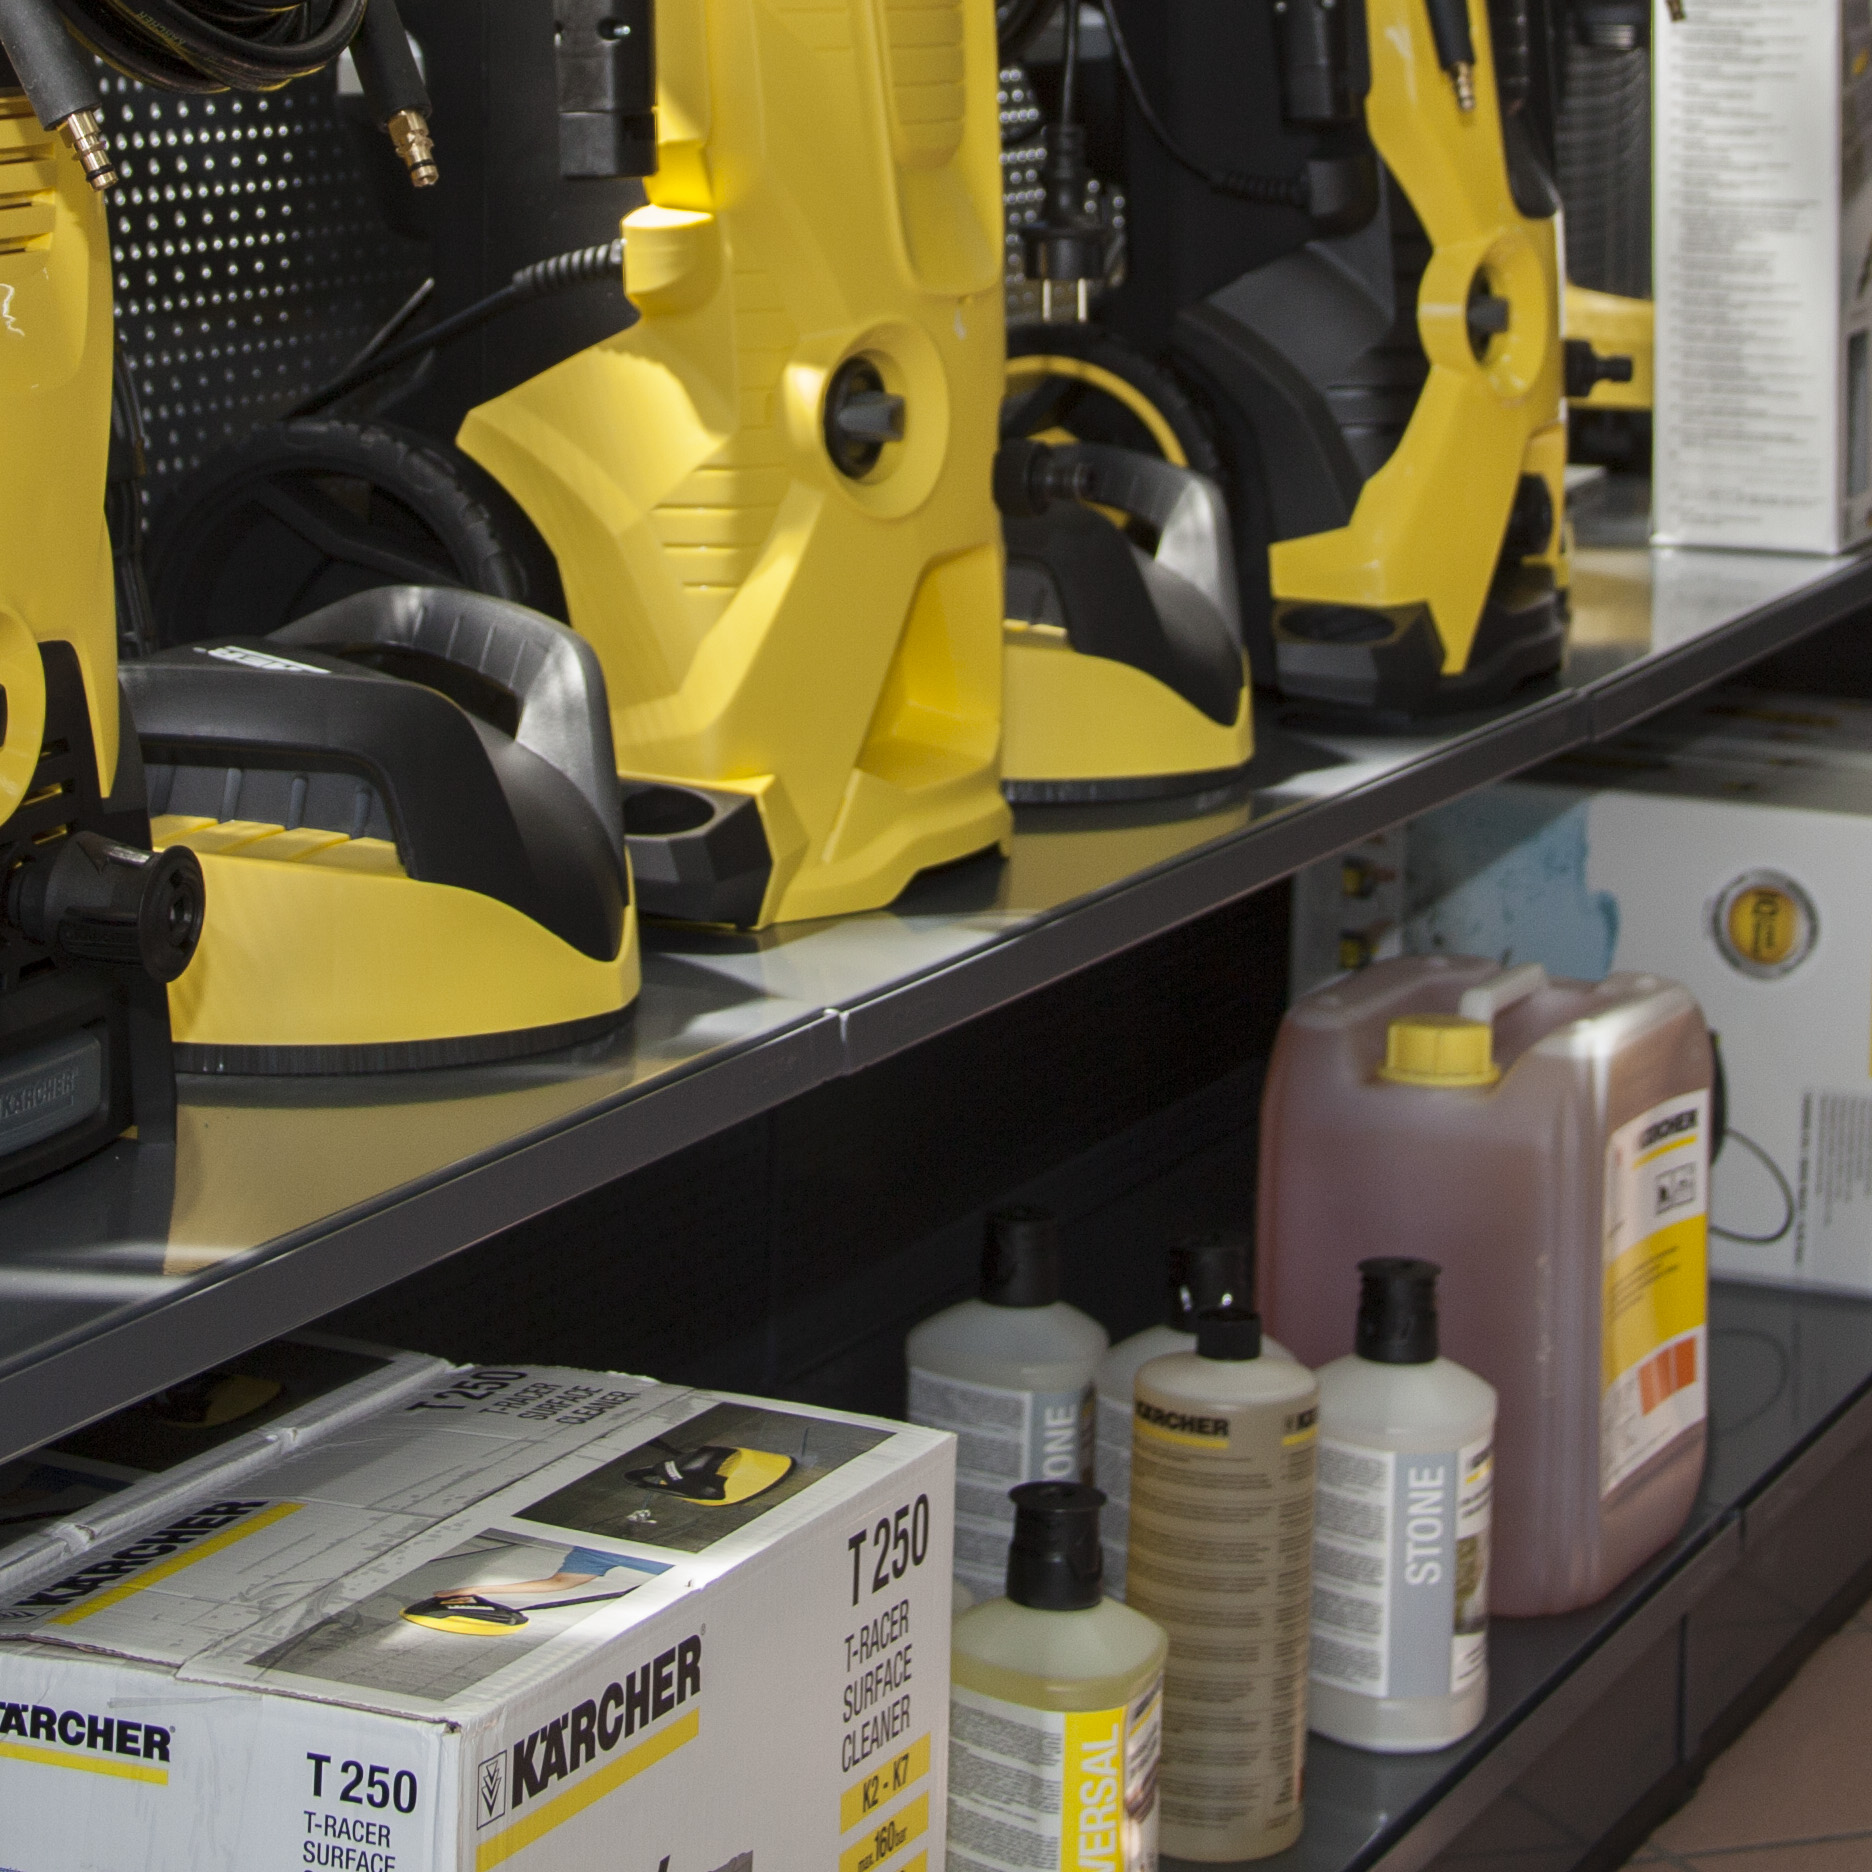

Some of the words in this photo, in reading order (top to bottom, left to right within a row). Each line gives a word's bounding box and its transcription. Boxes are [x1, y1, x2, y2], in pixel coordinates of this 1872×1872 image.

[404, 1400, 467, 1413] T
[433, 1370, 529, 1401] 250
[478, 1382, 564, 1415] T-RACER
[12, 1500, 270, 1607] KÄRCHER
[847, 1528, 868, 1608] T
[871, 1492, 929, 1595] 250
[1404, 1466, 1445, 1586] STONE
[844, 1598, 910, 1674] T-RACER
[843, 1642, 913, 1724] SURFACE
[511, 1634, 702, 1811] KÄRCHER
[841, 1692, 911, 1774] CLEANER
[305, 1750, 332, 1798] T
[338, 1757, 418, 1816] 250
[862, 1774, 880, 1814] K2
[892, 1751, 910, 1790] K7
[301, 1839, 397, 1872] SURFACE
[302, 1809, 393, 1850] T-RACER
